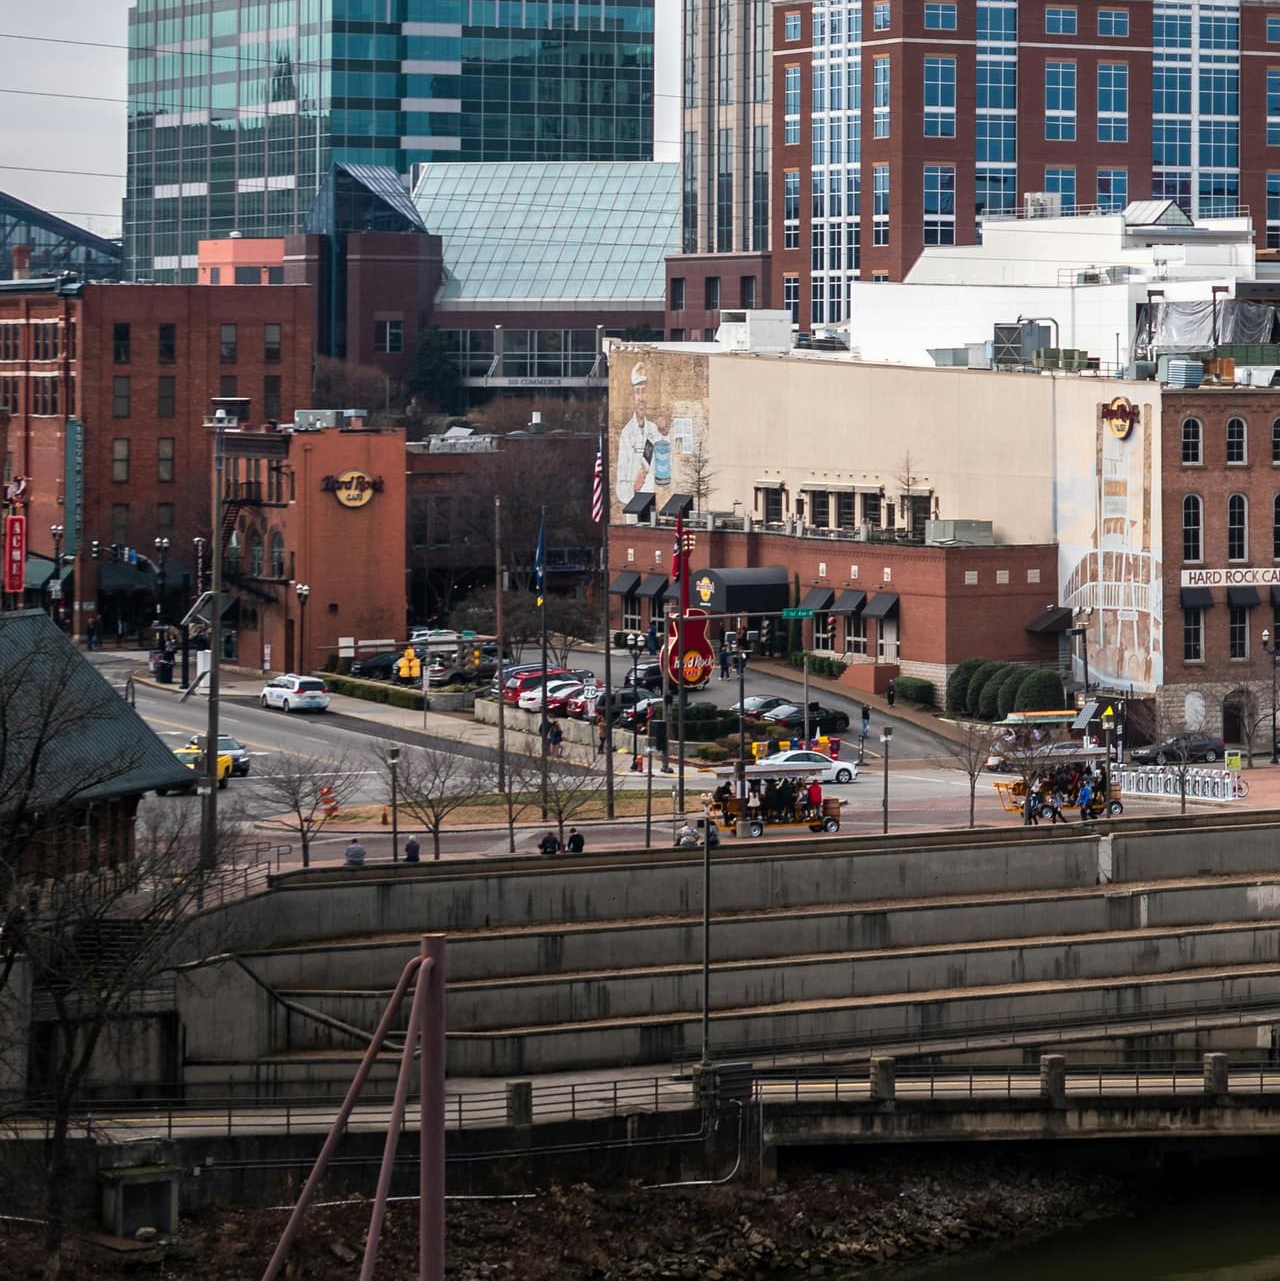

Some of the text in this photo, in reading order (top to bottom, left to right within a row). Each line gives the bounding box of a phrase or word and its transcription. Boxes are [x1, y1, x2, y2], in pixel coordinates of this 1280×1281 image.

[1189, 571, 1222, 585] HARD
[1225, 570, 1261, 584] ROCK
[586, 688, 596, 696] 70
